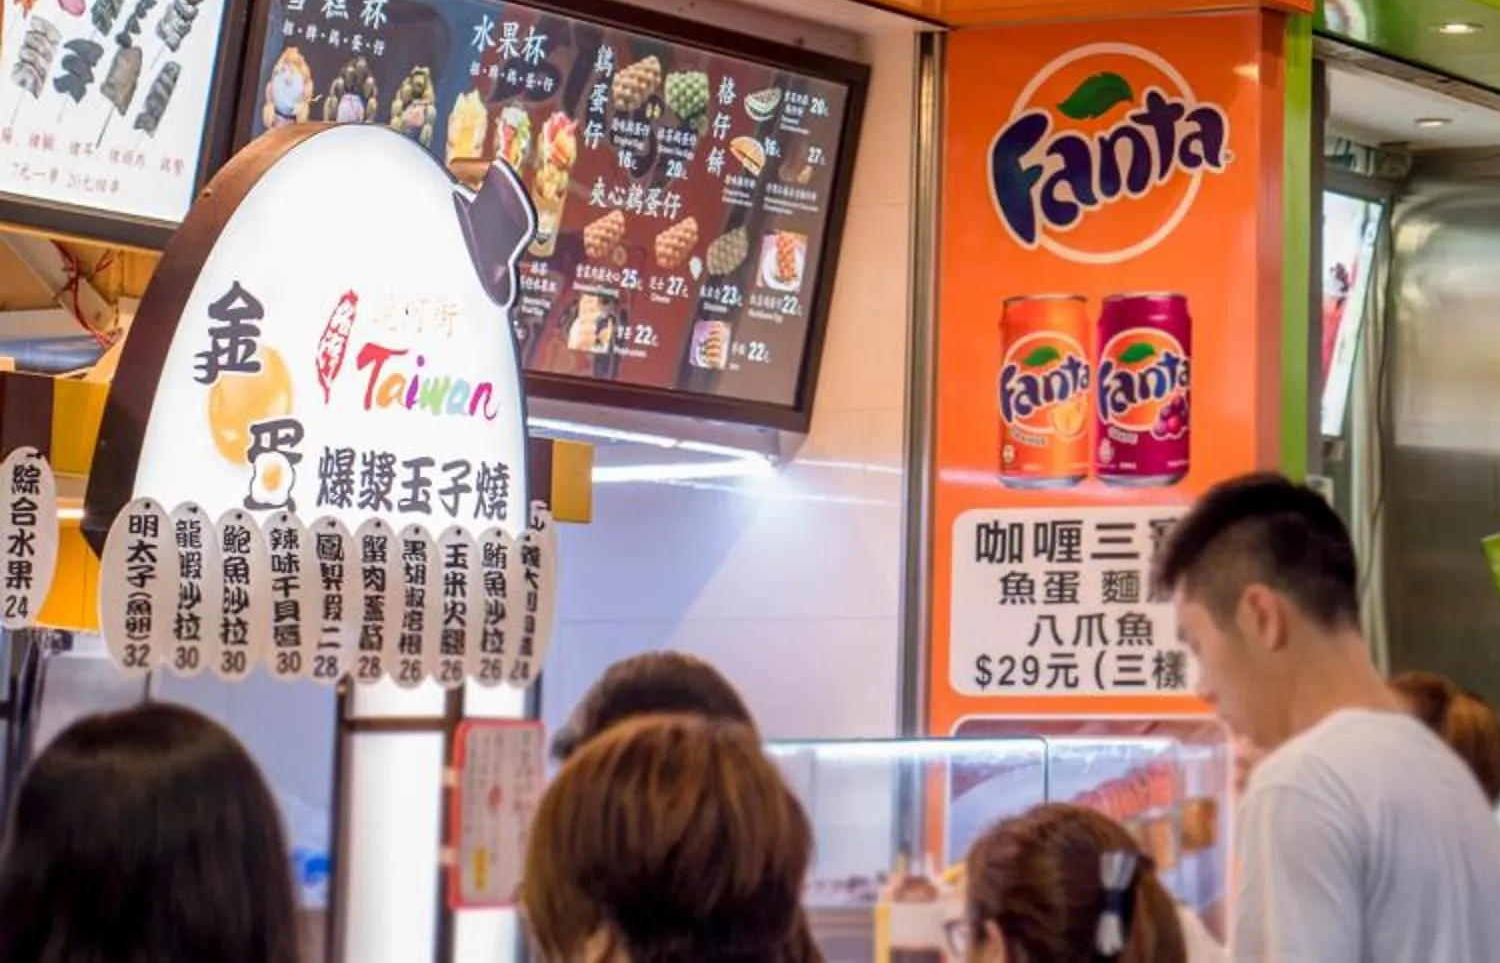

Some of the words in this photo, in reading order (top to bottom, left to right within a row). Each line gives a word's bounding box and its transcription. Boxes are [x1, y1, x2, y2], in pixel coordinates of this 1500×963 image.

[470, 14, 549, 66] 水果杯
[989, 87, 1228, 246] Fanta
[356, 341, 501, 421] Taiwan
[316, 445, 512, 521] 爆漿玉子燒
[5, 464, 42, 589] 綜合水果
[125, 514, 159, 641] 明太子(魚卵)
[220, 524, 252, 646] 鮑魚沙拉
[999, 570, 1081, 605] 魚蛋
[4, 594, 29, 619] 24
[1027, 611, 1154, 647] 八爪魚
[123, 644, 151, 668] 32
[174, 645, 200, 670] 30
[220, 650, 247, 674] 30
[276, 650, 302, 675] 30
[313, 655, 339, 678] 28
[358, 655, 382, 678] 28
[479, 657, 503, 680] 26
[400, 659, 422, 682] 26
[440, 658, 464, 682] 26
